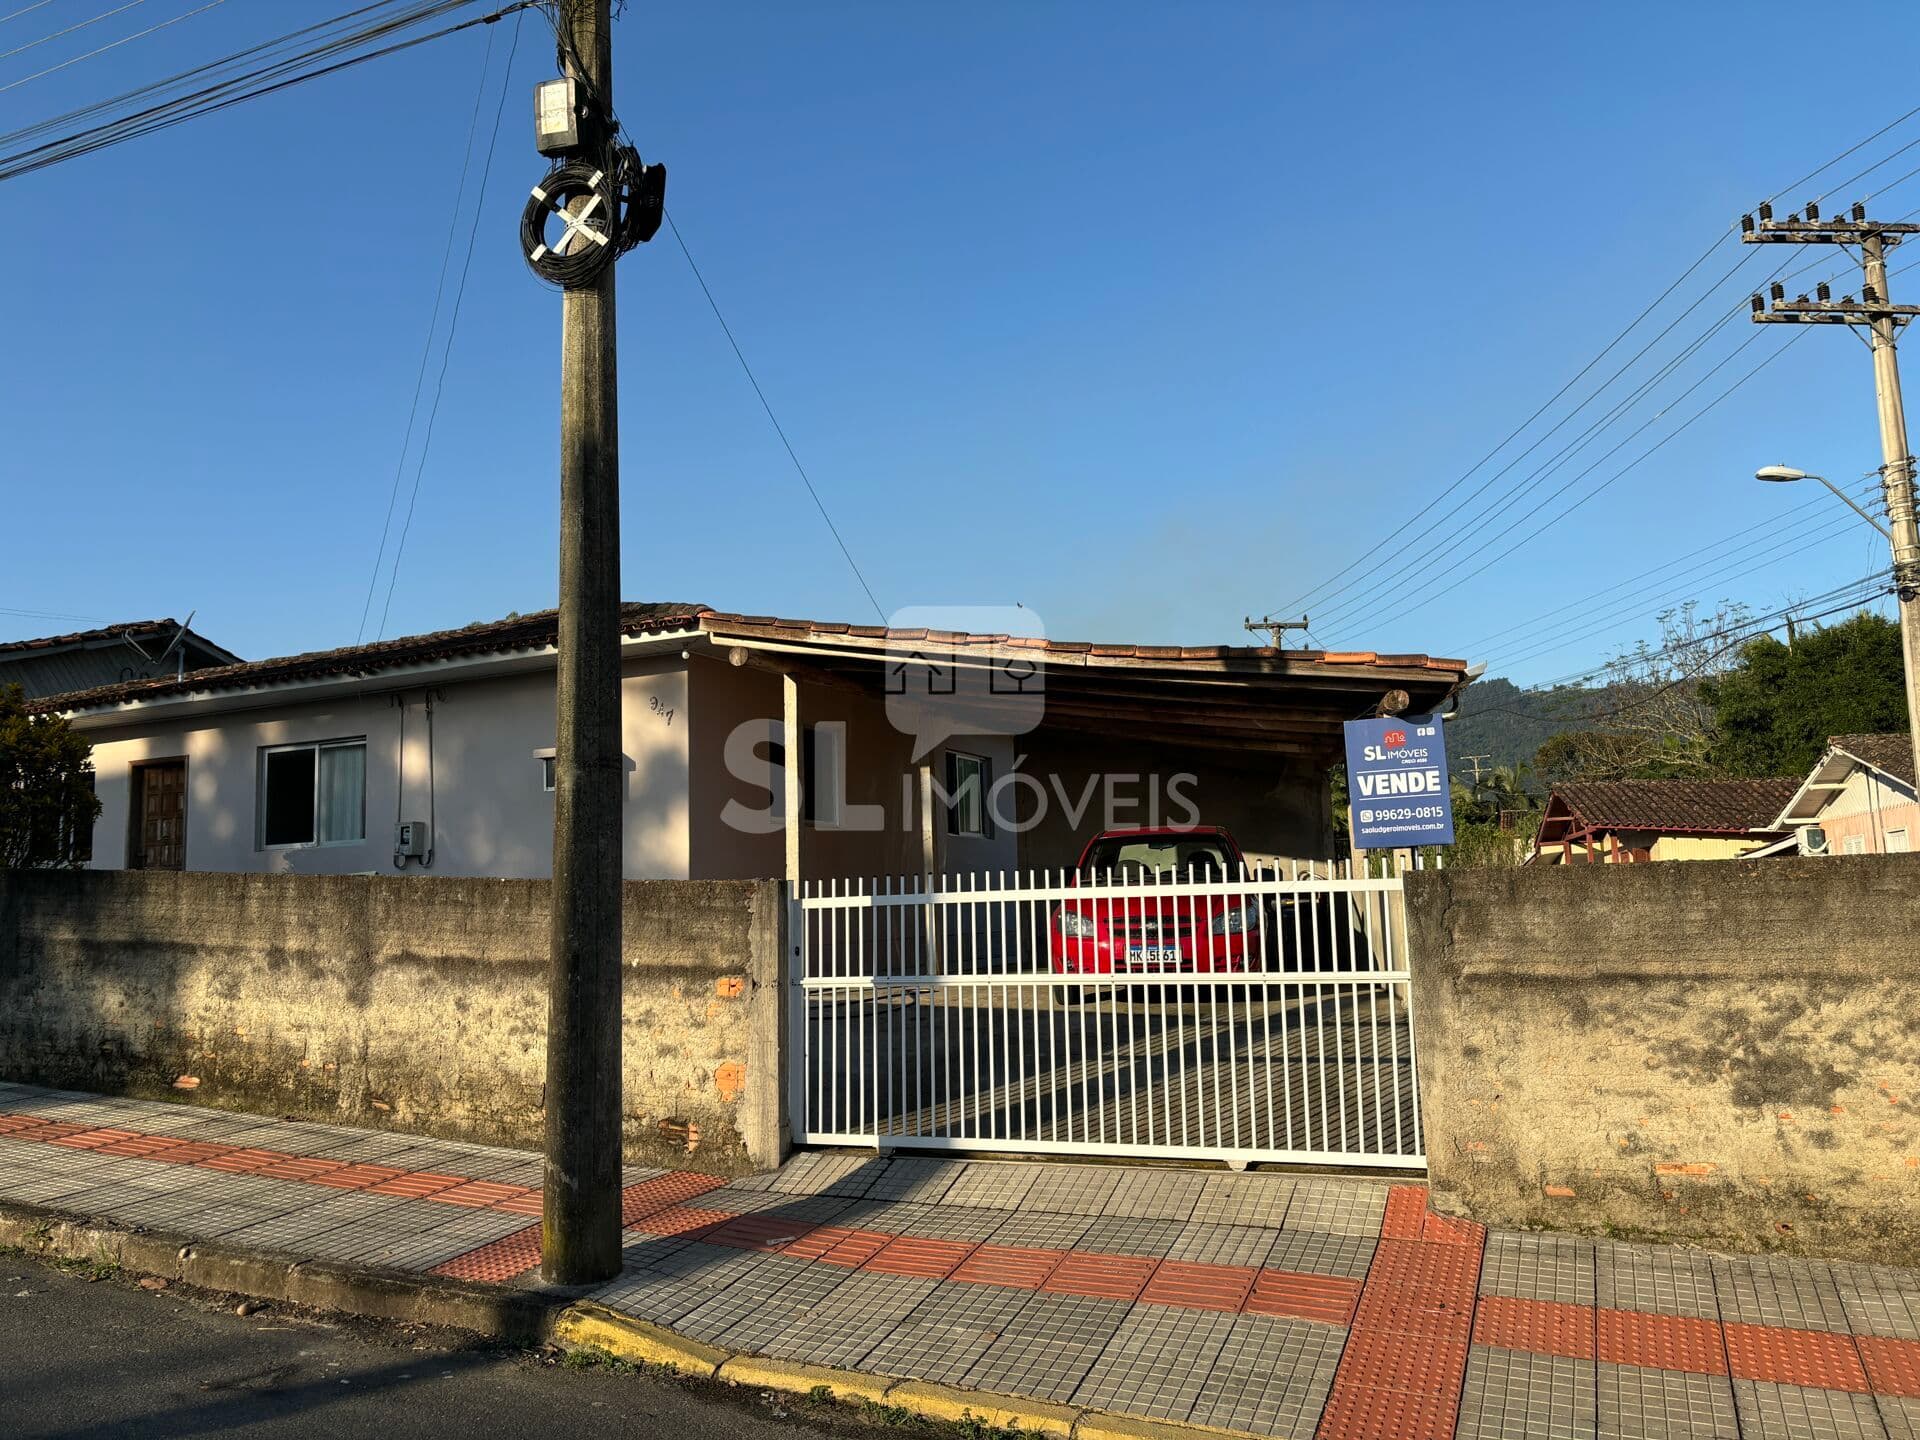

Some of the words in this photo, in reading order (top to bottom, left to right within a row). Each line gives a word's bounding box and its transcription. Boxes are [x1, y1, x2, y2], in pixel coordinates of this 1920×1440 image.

[1363, 745, 1387, 761] SL
[1387, 748, 1428, 759] IMÓVEIS
[1357, 770, 1441, 796] VENDE
[1375, 806, 1443, 821] 99629-0815
[1361, 823, 1444, 834] saoludgeroimoveis.com.br
